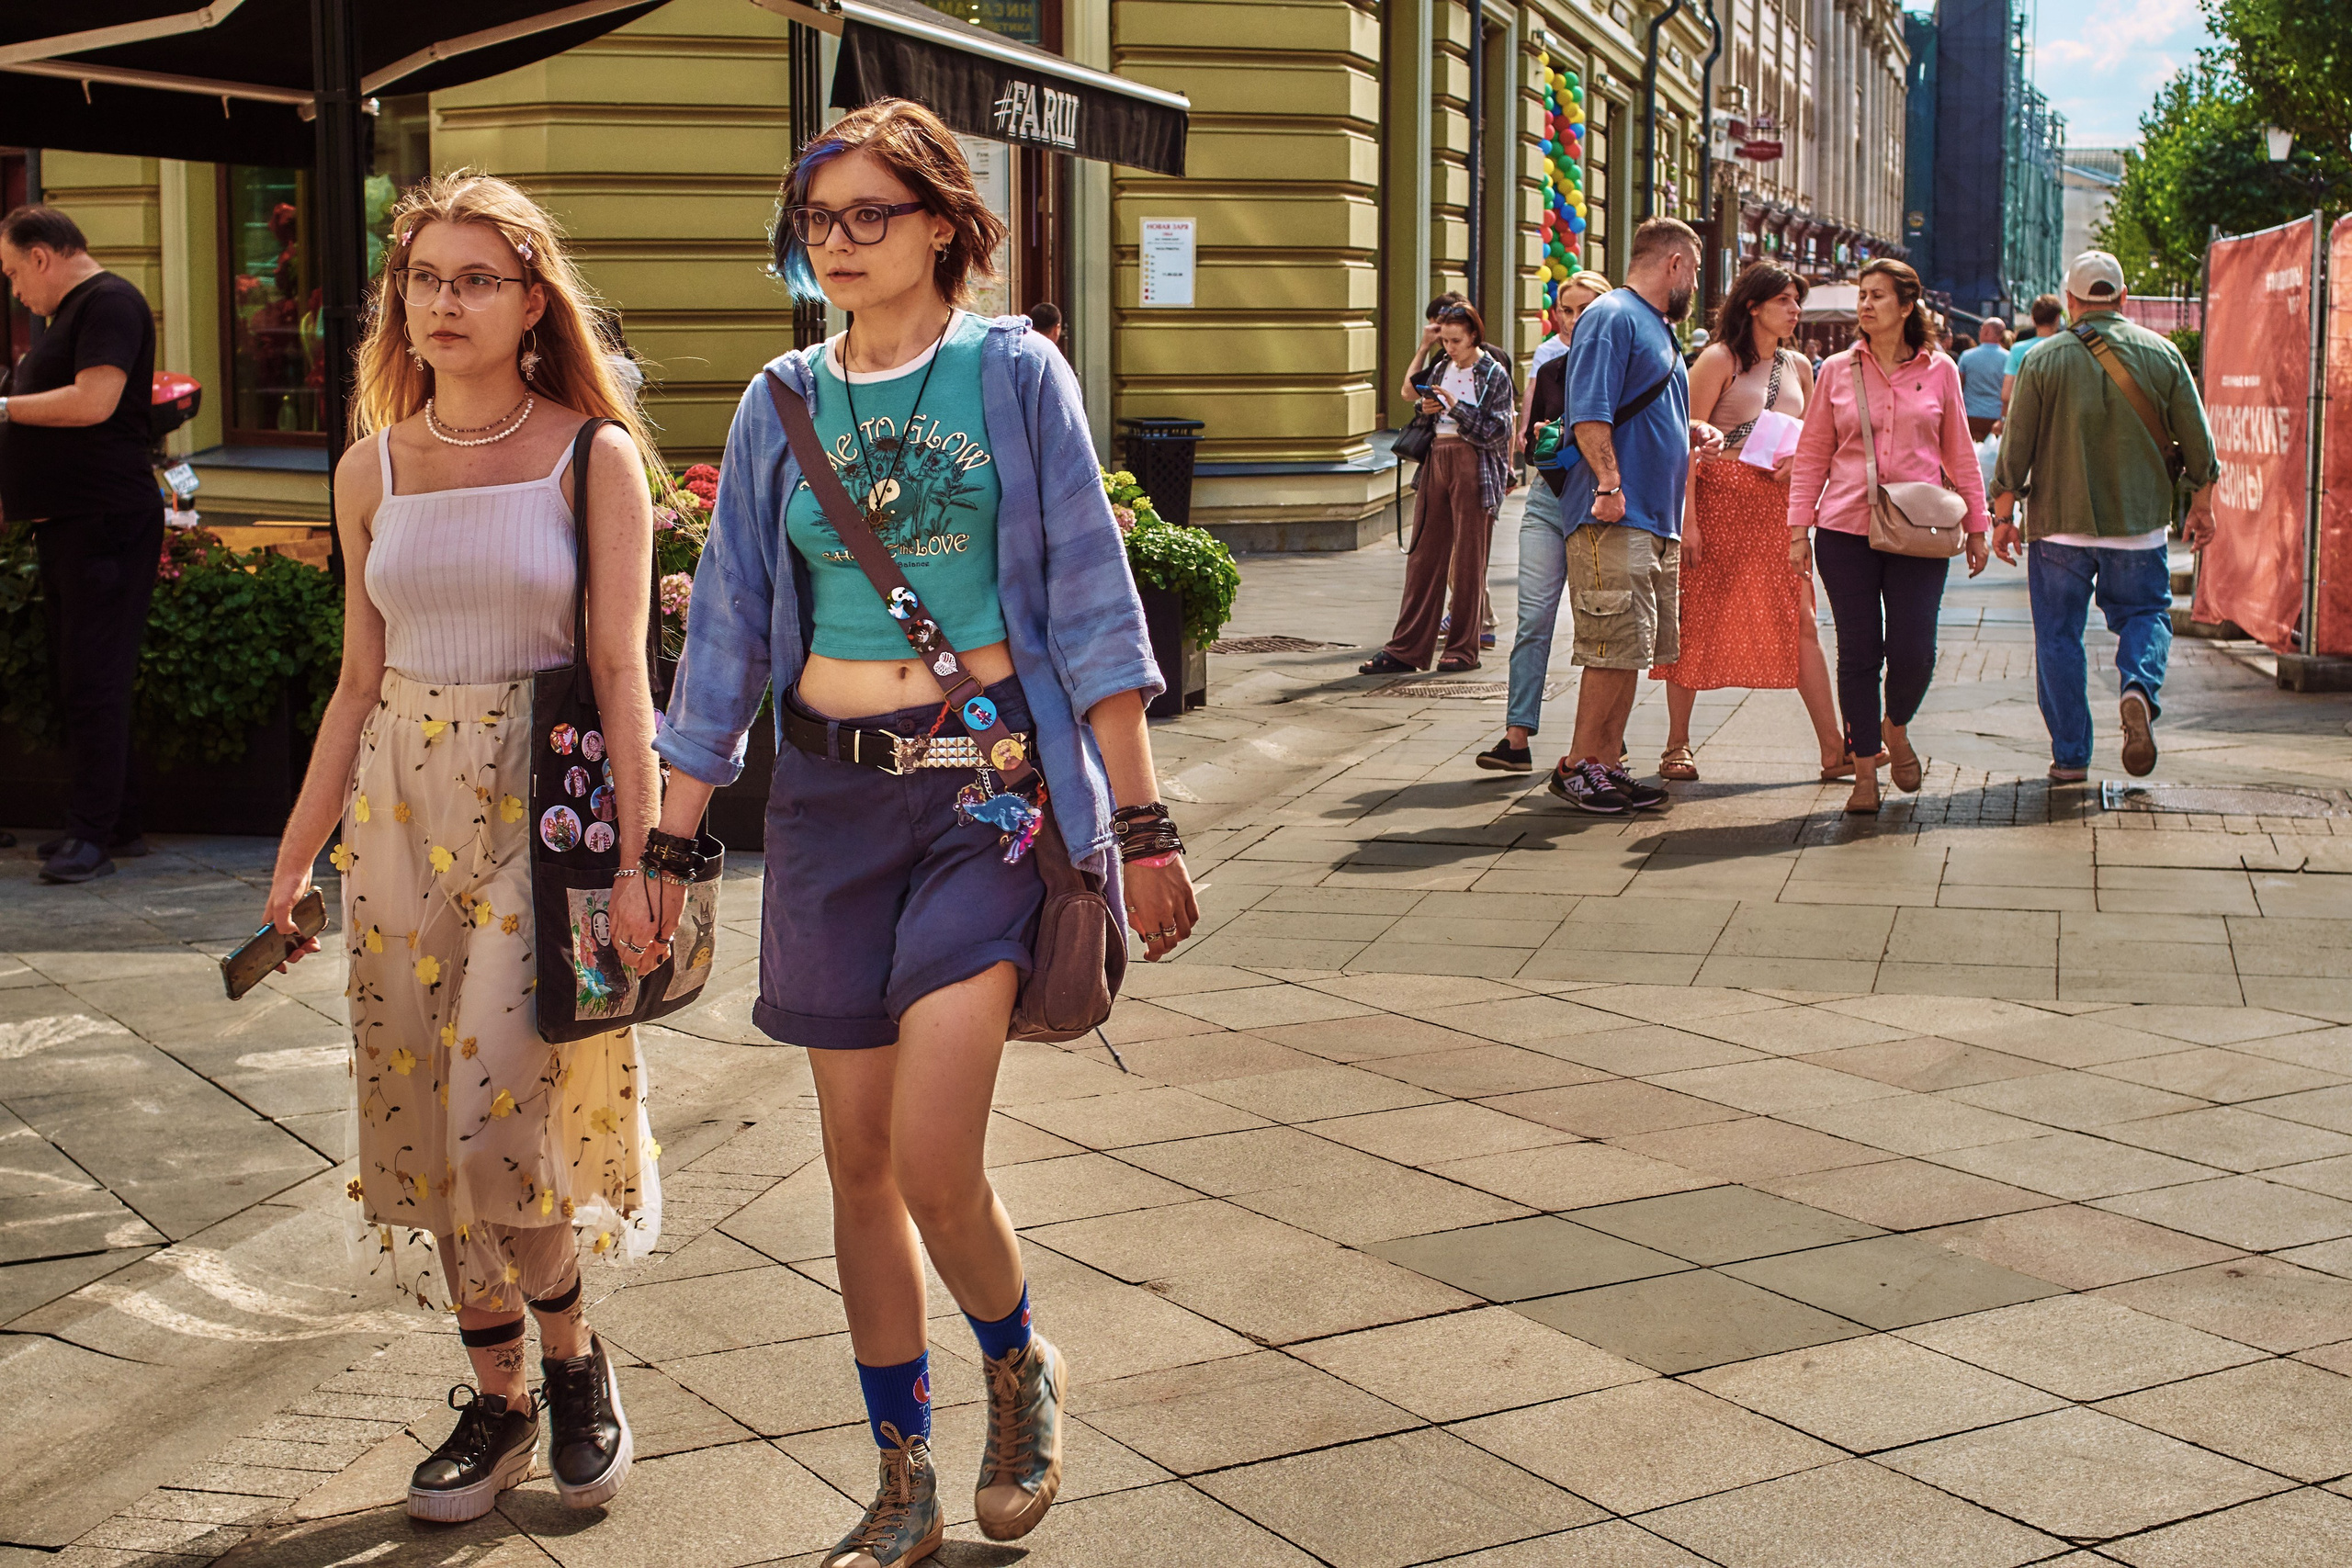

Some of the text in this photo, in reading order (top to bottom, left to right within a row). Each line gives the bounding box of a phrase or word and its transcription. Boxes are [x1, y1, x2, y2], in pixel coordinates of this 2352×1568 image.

[860, 416, 895, 445] TO
[903, 413, 991, 471] GLOW
[915, 534, 970, 557] LOVE
